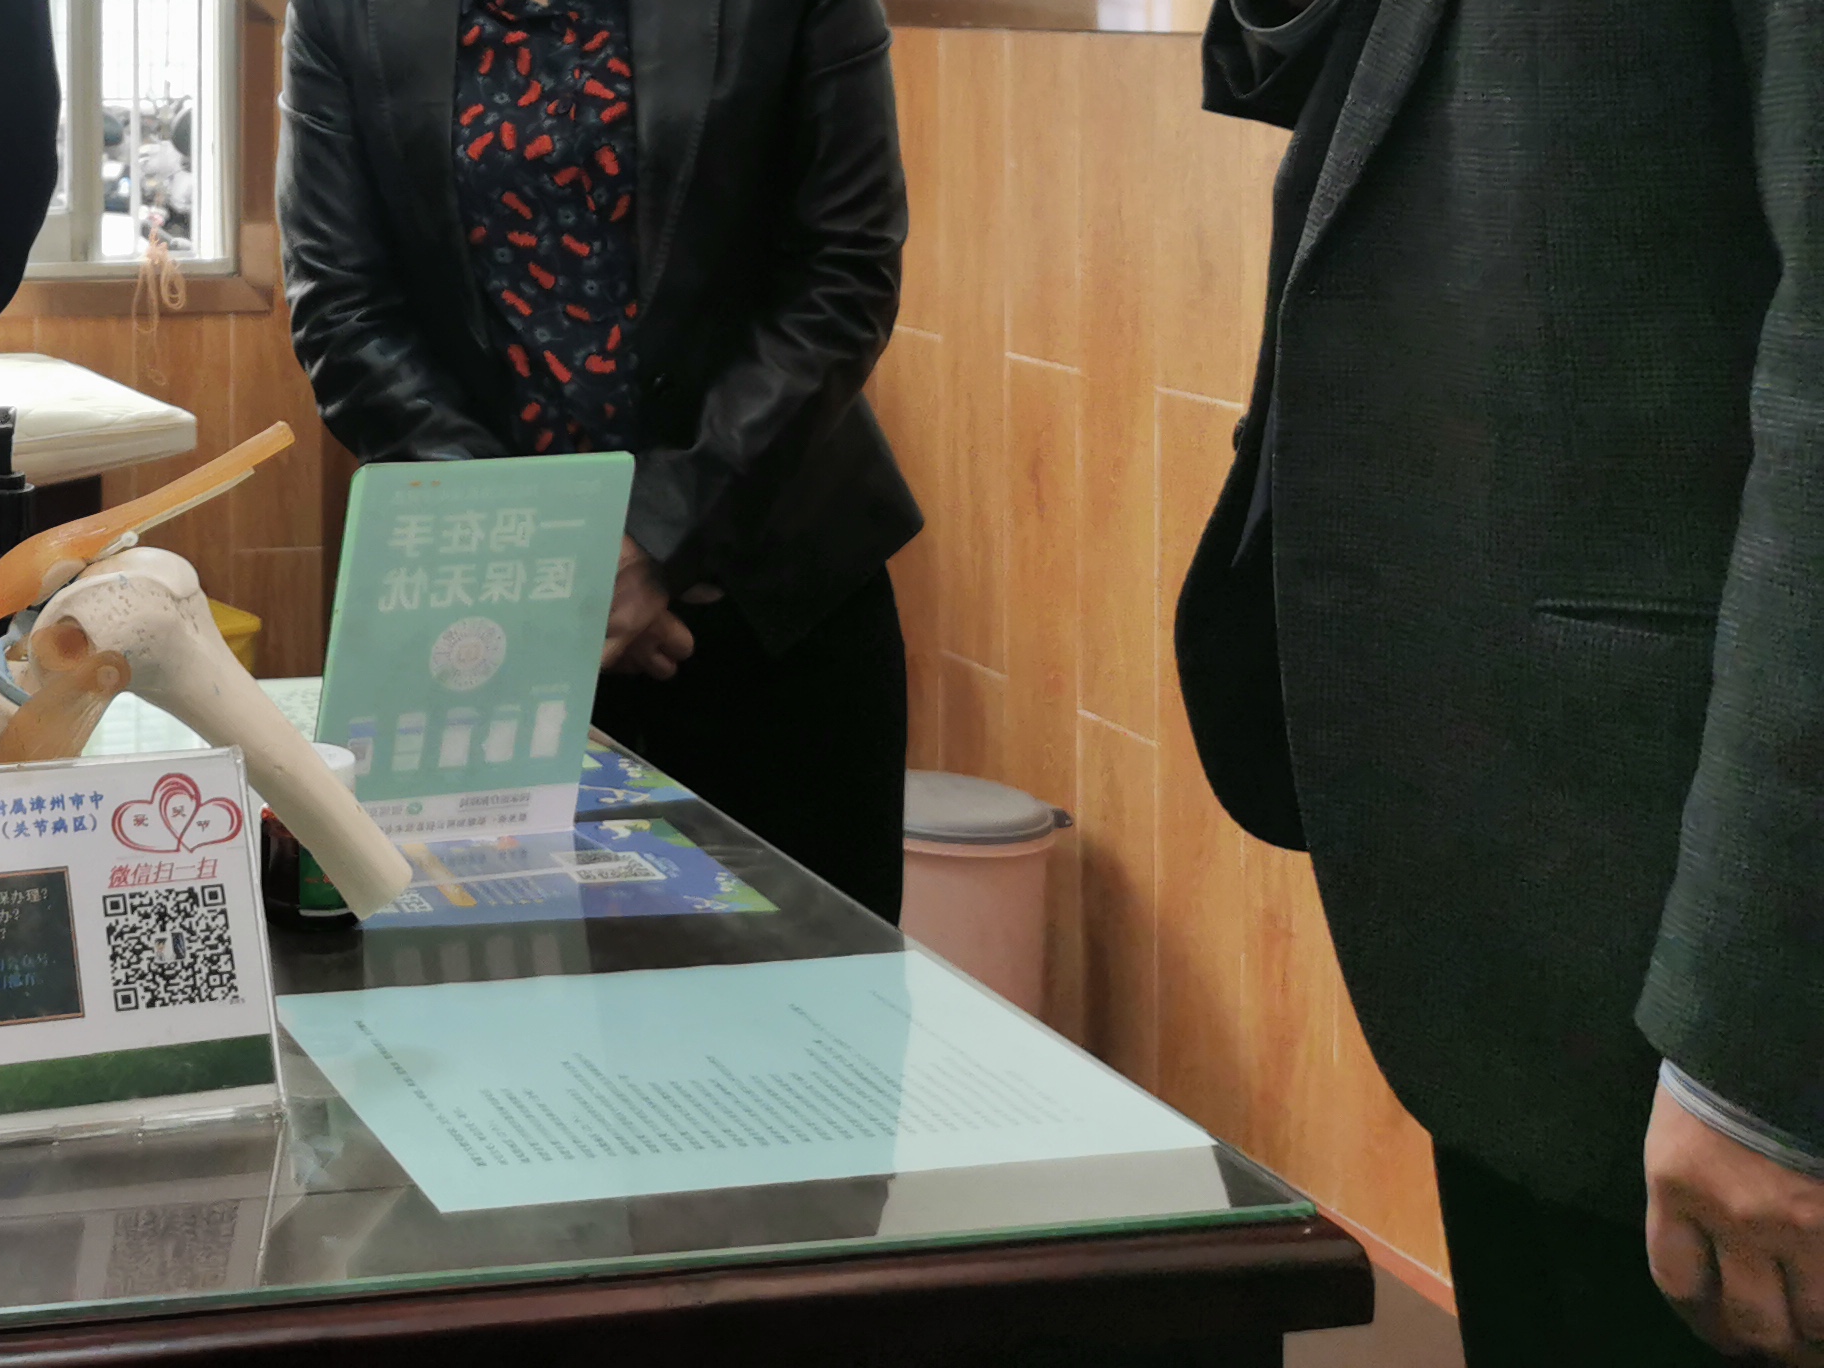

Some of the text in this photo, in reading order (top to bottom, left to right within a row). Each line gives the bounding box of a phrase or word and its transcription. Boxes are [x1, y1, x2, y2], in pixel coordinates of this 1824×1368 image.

[108, 856, 218, 887] 微信扫一扫
